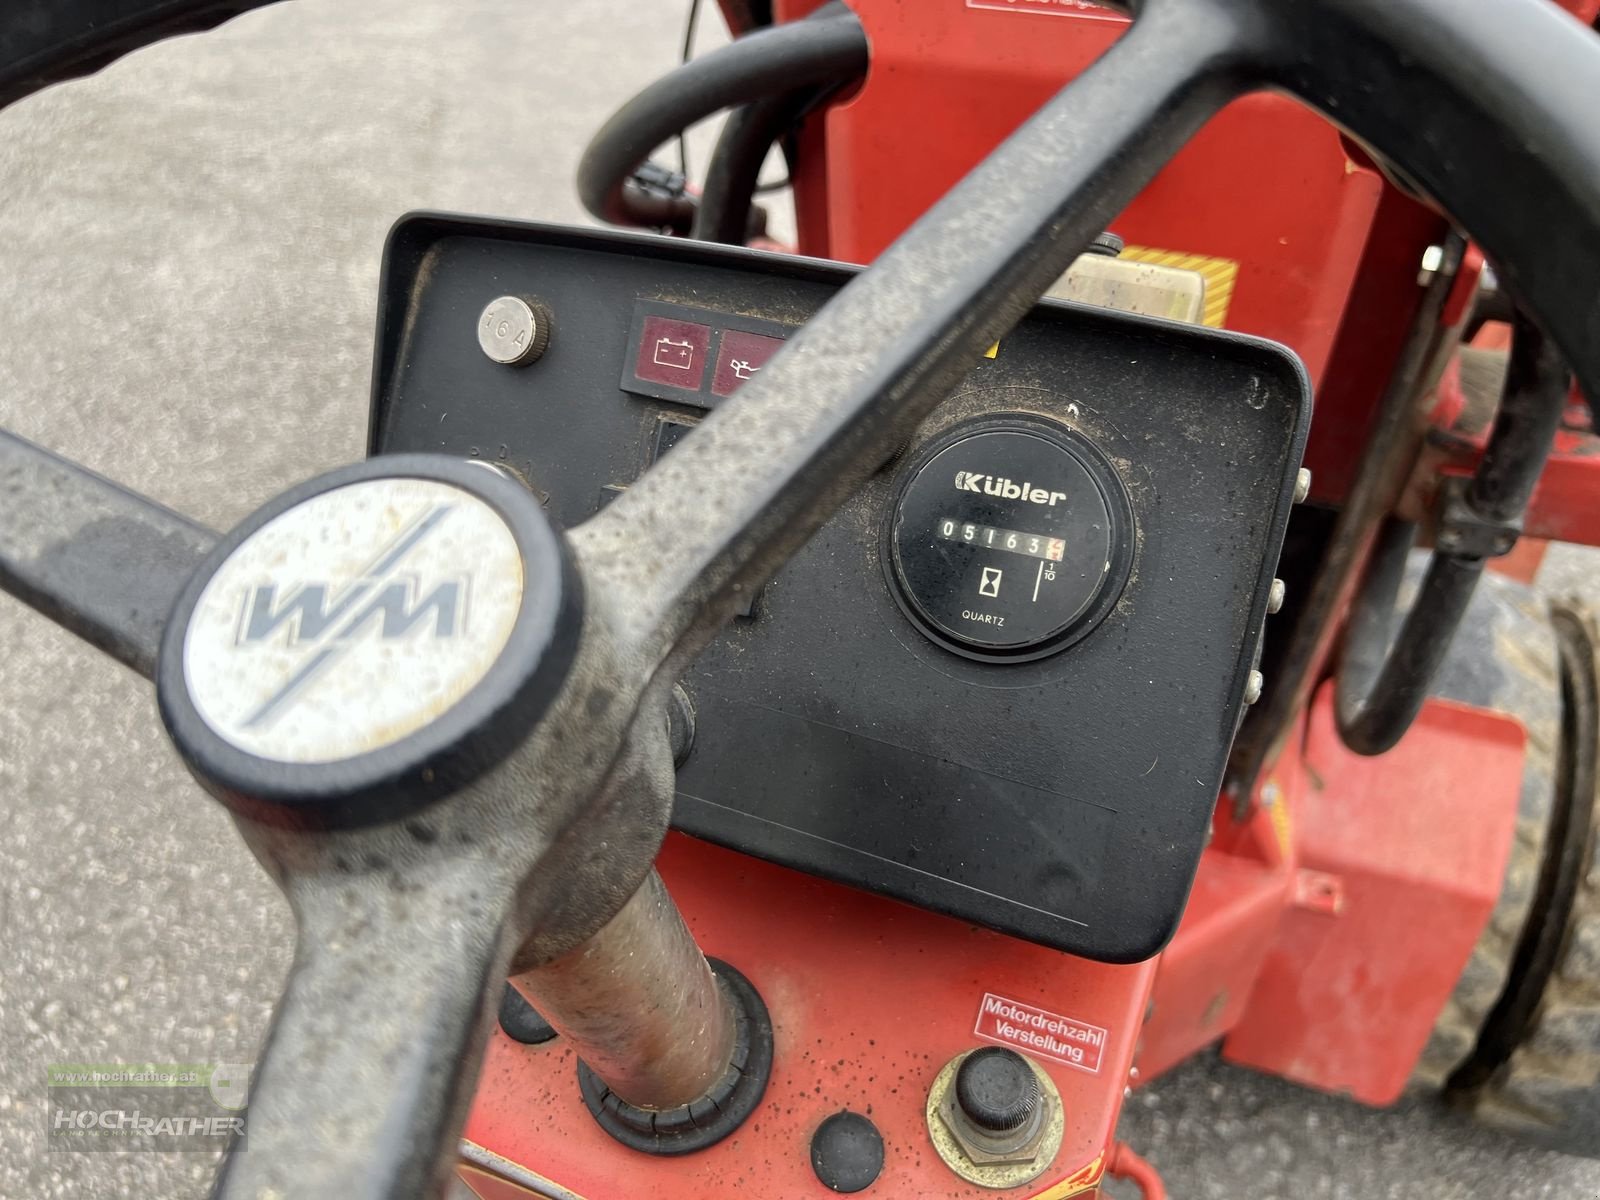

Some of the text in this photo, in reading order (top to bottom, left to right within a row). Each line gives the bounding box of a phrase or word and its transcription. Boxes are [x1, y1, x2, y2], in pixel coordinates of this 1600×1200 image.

[960, 471, 1067, 506] Kübler
[961, 610, 1005, 627] QUARTZ
[985, 998, 1102, 1046] Motordrehzahl
[995, 1019, 1084, 1062] Verstellung
